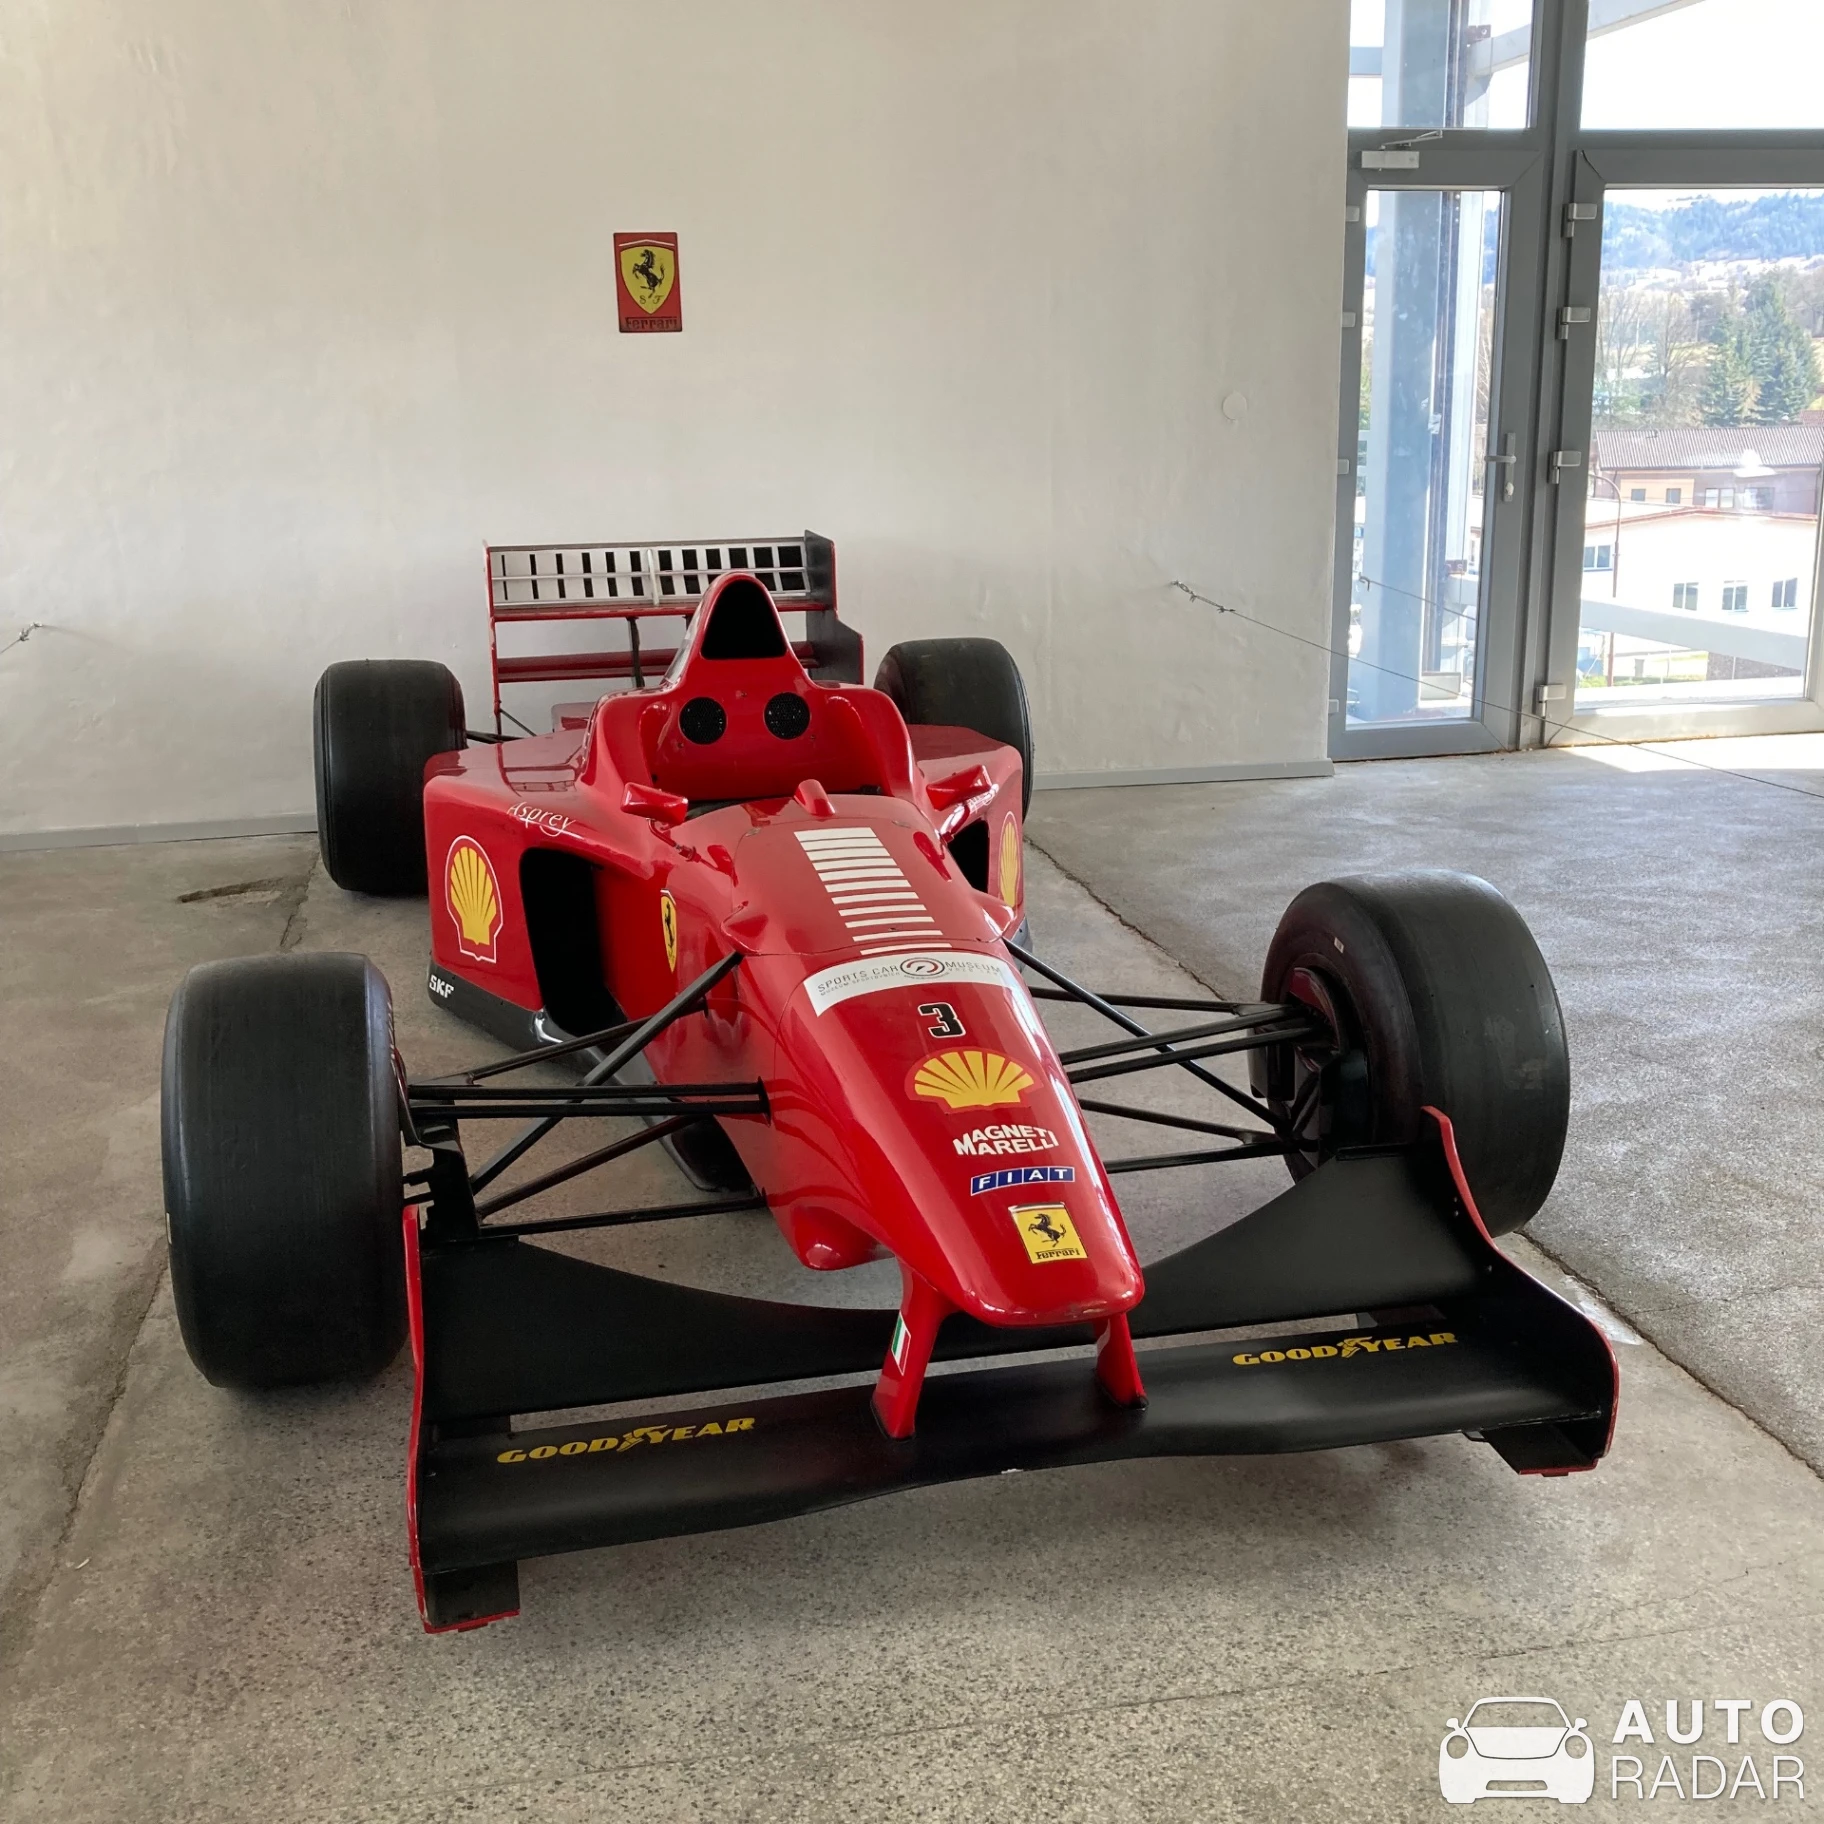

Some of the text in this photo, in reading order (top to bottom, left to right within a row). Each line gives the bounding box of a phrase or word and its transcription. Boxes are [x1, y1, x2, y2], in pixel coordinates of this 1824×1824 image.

[624, 316, 678, 330] Ferrari
[506, 801, 577, 837] Asprey
[429, 974, 455, 998] SKF
[817, 970, 868, 993] SPORTS
[872, 964, 899, 976] CAR
[944, 961, 1001, 973] MUSEUM
[918, 1002, 966, 1039] 3
[953, 1124, 1058, 1150] MAGNETI
[953, 1134, 1059, 1155] MARELLI
[978, 1168, 1068, 1190] FIAT
[1035, 1247, 1081, 1260] Ferrari
